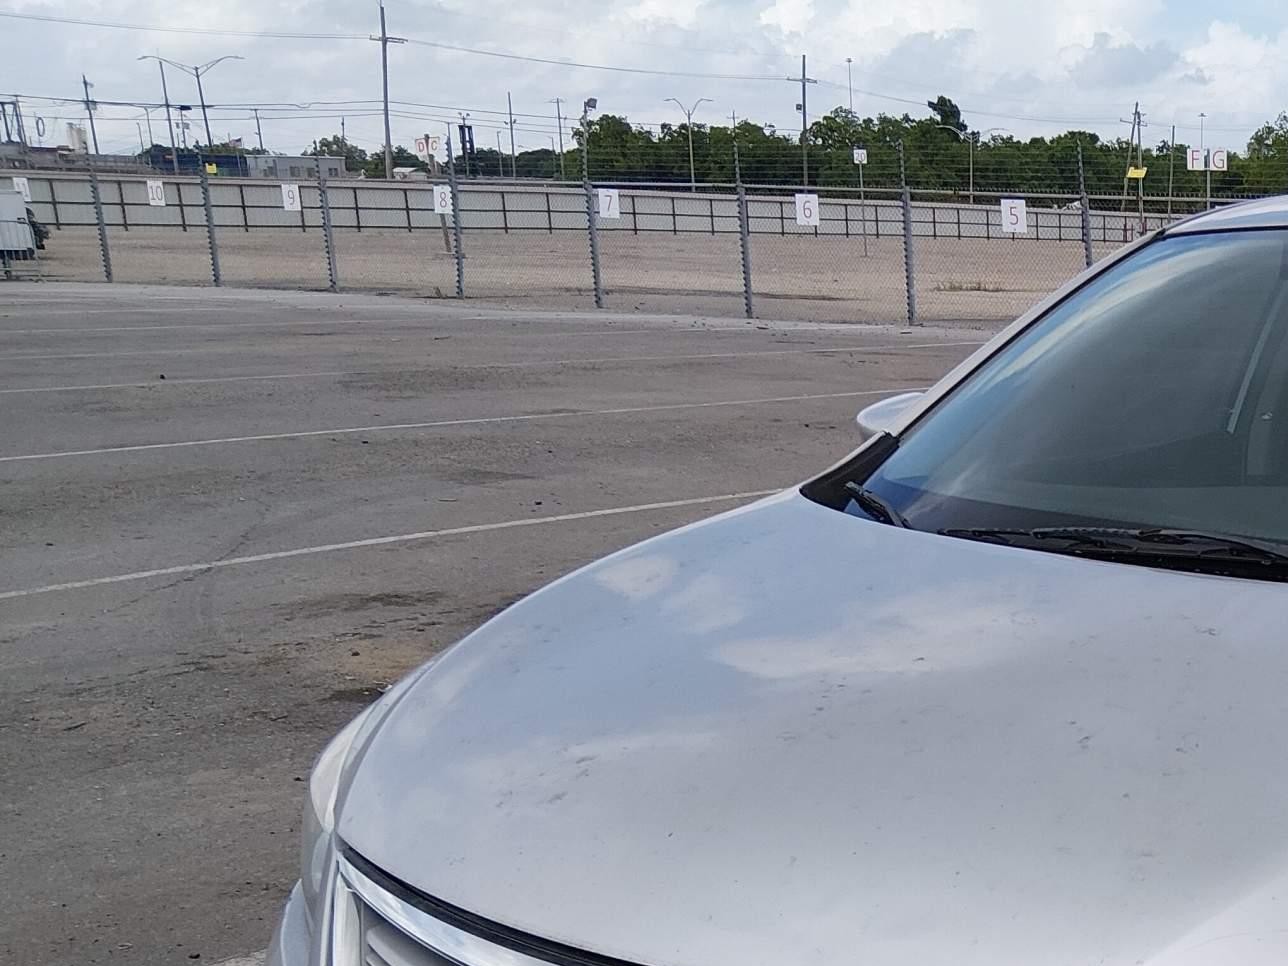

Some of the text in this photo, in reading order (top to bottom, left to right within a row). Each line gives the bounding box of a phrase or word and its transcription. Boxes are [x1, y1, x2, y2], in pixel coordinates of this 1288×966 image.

[418, 142, 425, 152] D
[431, 140, 438, 151] C
[1191, 150, 1200, 169] F
[1212, 150, 1225, 169] G
[150, 183, 163, 201] 10
[287, 189, 295, 205] 9
[440, 191, 447, 208] 8
[604, 194, 613, 212] 7
[803, 200, 812, 219] 6
[1009, 206, 1019, 225] 5
